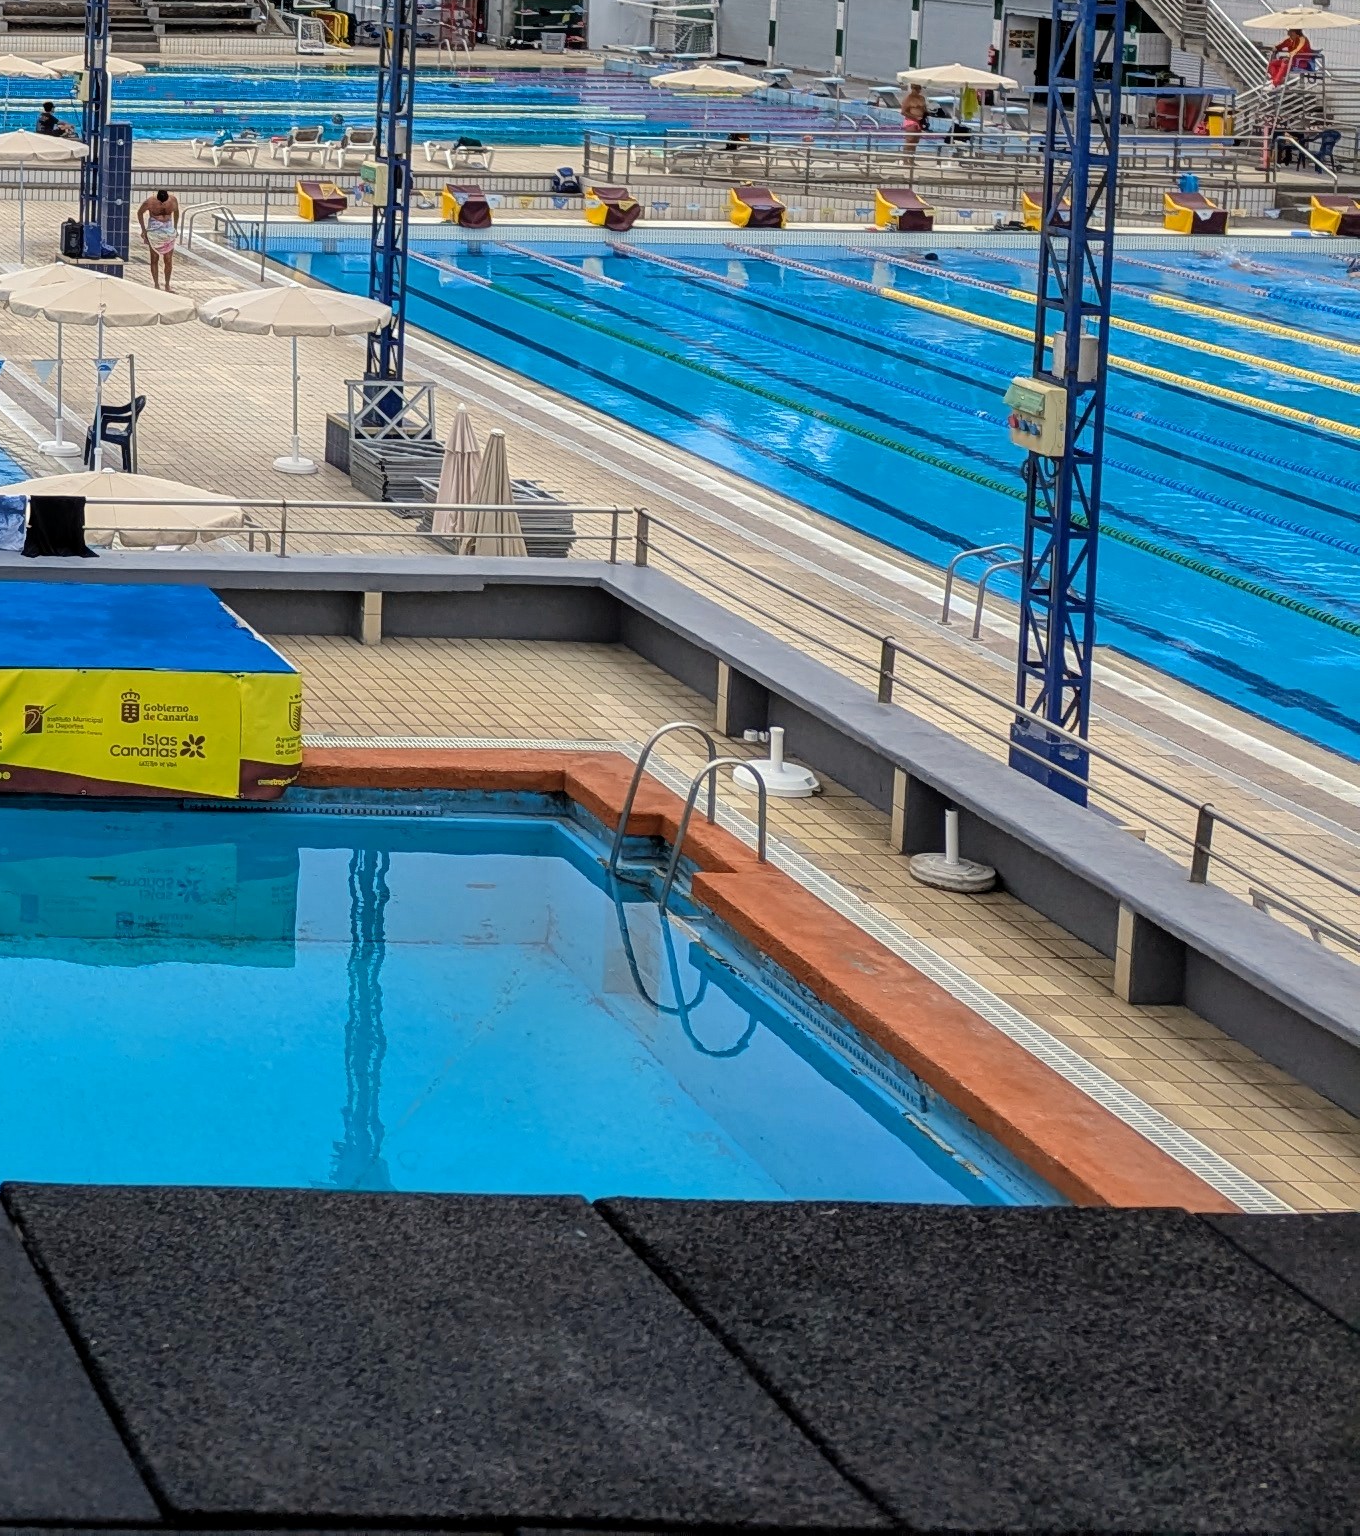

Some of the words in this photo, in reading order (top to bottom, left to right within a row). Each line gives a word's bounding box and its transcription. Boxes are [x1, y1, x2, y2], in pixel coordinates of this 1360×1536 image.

[144, 704, 190, 712] Gobierno
[144, 712, 156, 721] de
[156, 713, 199, 722] Canarias
[142, 732, 178, 746] Islas
[110, 744, 178, 758] Canarias
